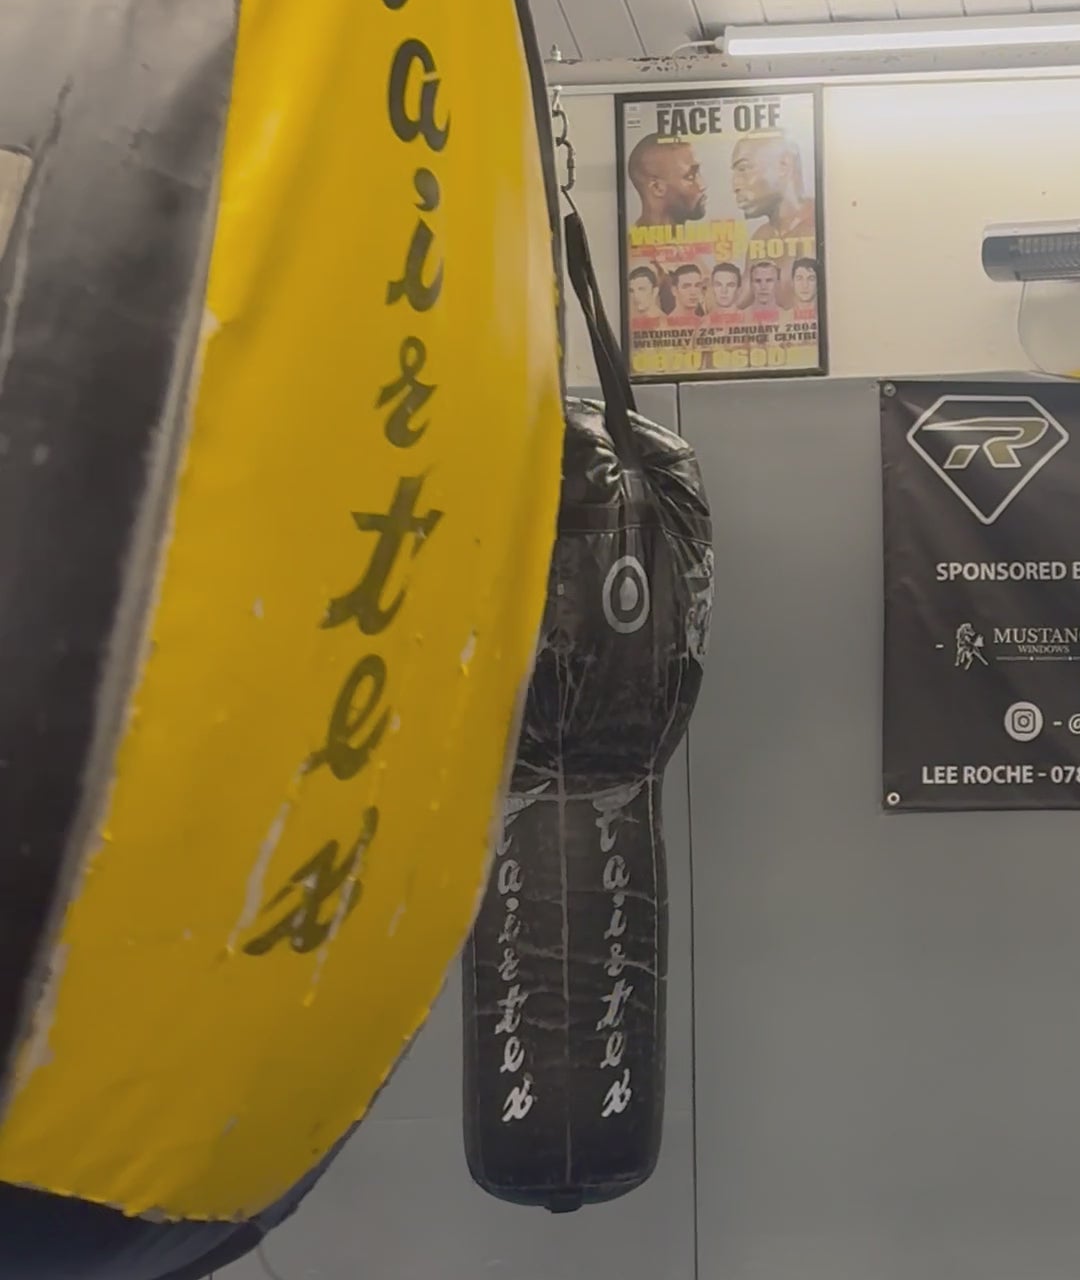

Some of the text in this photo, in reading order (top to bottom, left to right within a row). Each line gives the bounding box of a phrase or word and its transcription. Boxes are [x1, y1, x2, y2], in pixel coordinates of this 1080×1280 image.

[656, 106, 722, 136] FACE
[733, 103, 780, 132] OFF
[633, 329, 694, 339] SATURDAY
[728, 324, 779, 335] JANUARY
[785, 322, 816, 332] 2004
[774, 331, 817, 342] CENTRE
[936, 562, 1066, 581] SPONSORED
[1018, 644, 1070, 654] WINDOWS
[922, 766, 958, 784] LEE
[963, 766, 1034, 784] ROCHE
